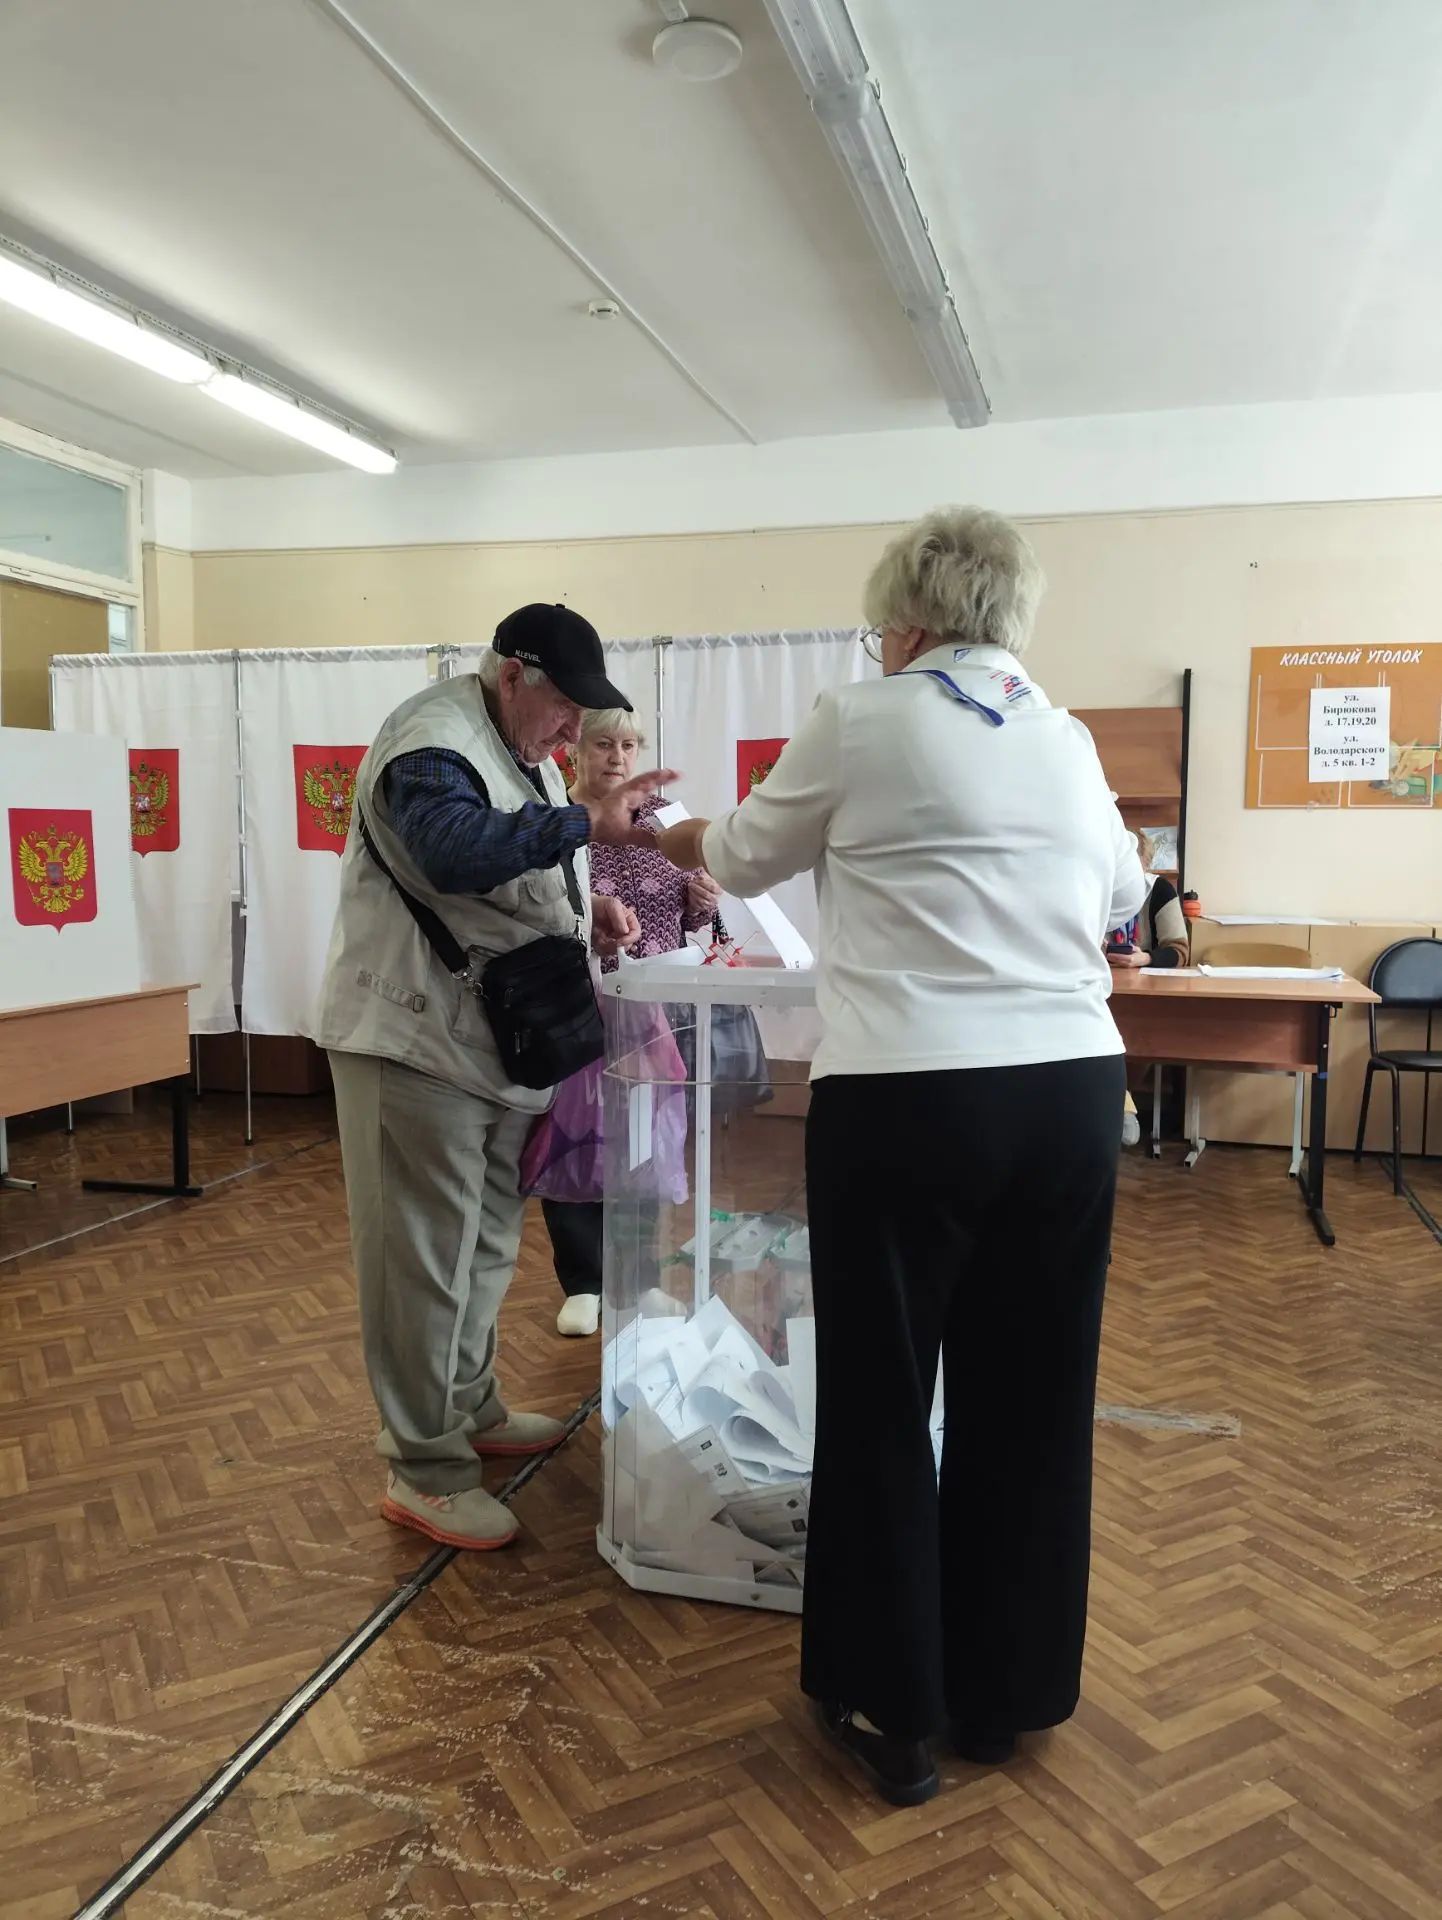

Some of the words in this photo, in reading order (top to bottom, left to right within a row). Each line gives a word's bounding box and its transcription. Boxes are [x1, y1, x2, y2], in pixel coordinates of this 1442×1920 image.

[1280, 648, 1362, 666] КЛАССНЫЙ
[1366, 649, 1423, 664] УГОЛОК
[1344, 695, 1359, 703] ул.
[1323, 705, 1376, 715] Бирюкова
[1344, 736, 1358, 744] ул.
[1314, 747, 1385, 756] Володарского
[1333, 758, 1339, 766] 5
[1361, 757, 1375, 766] 1-2
